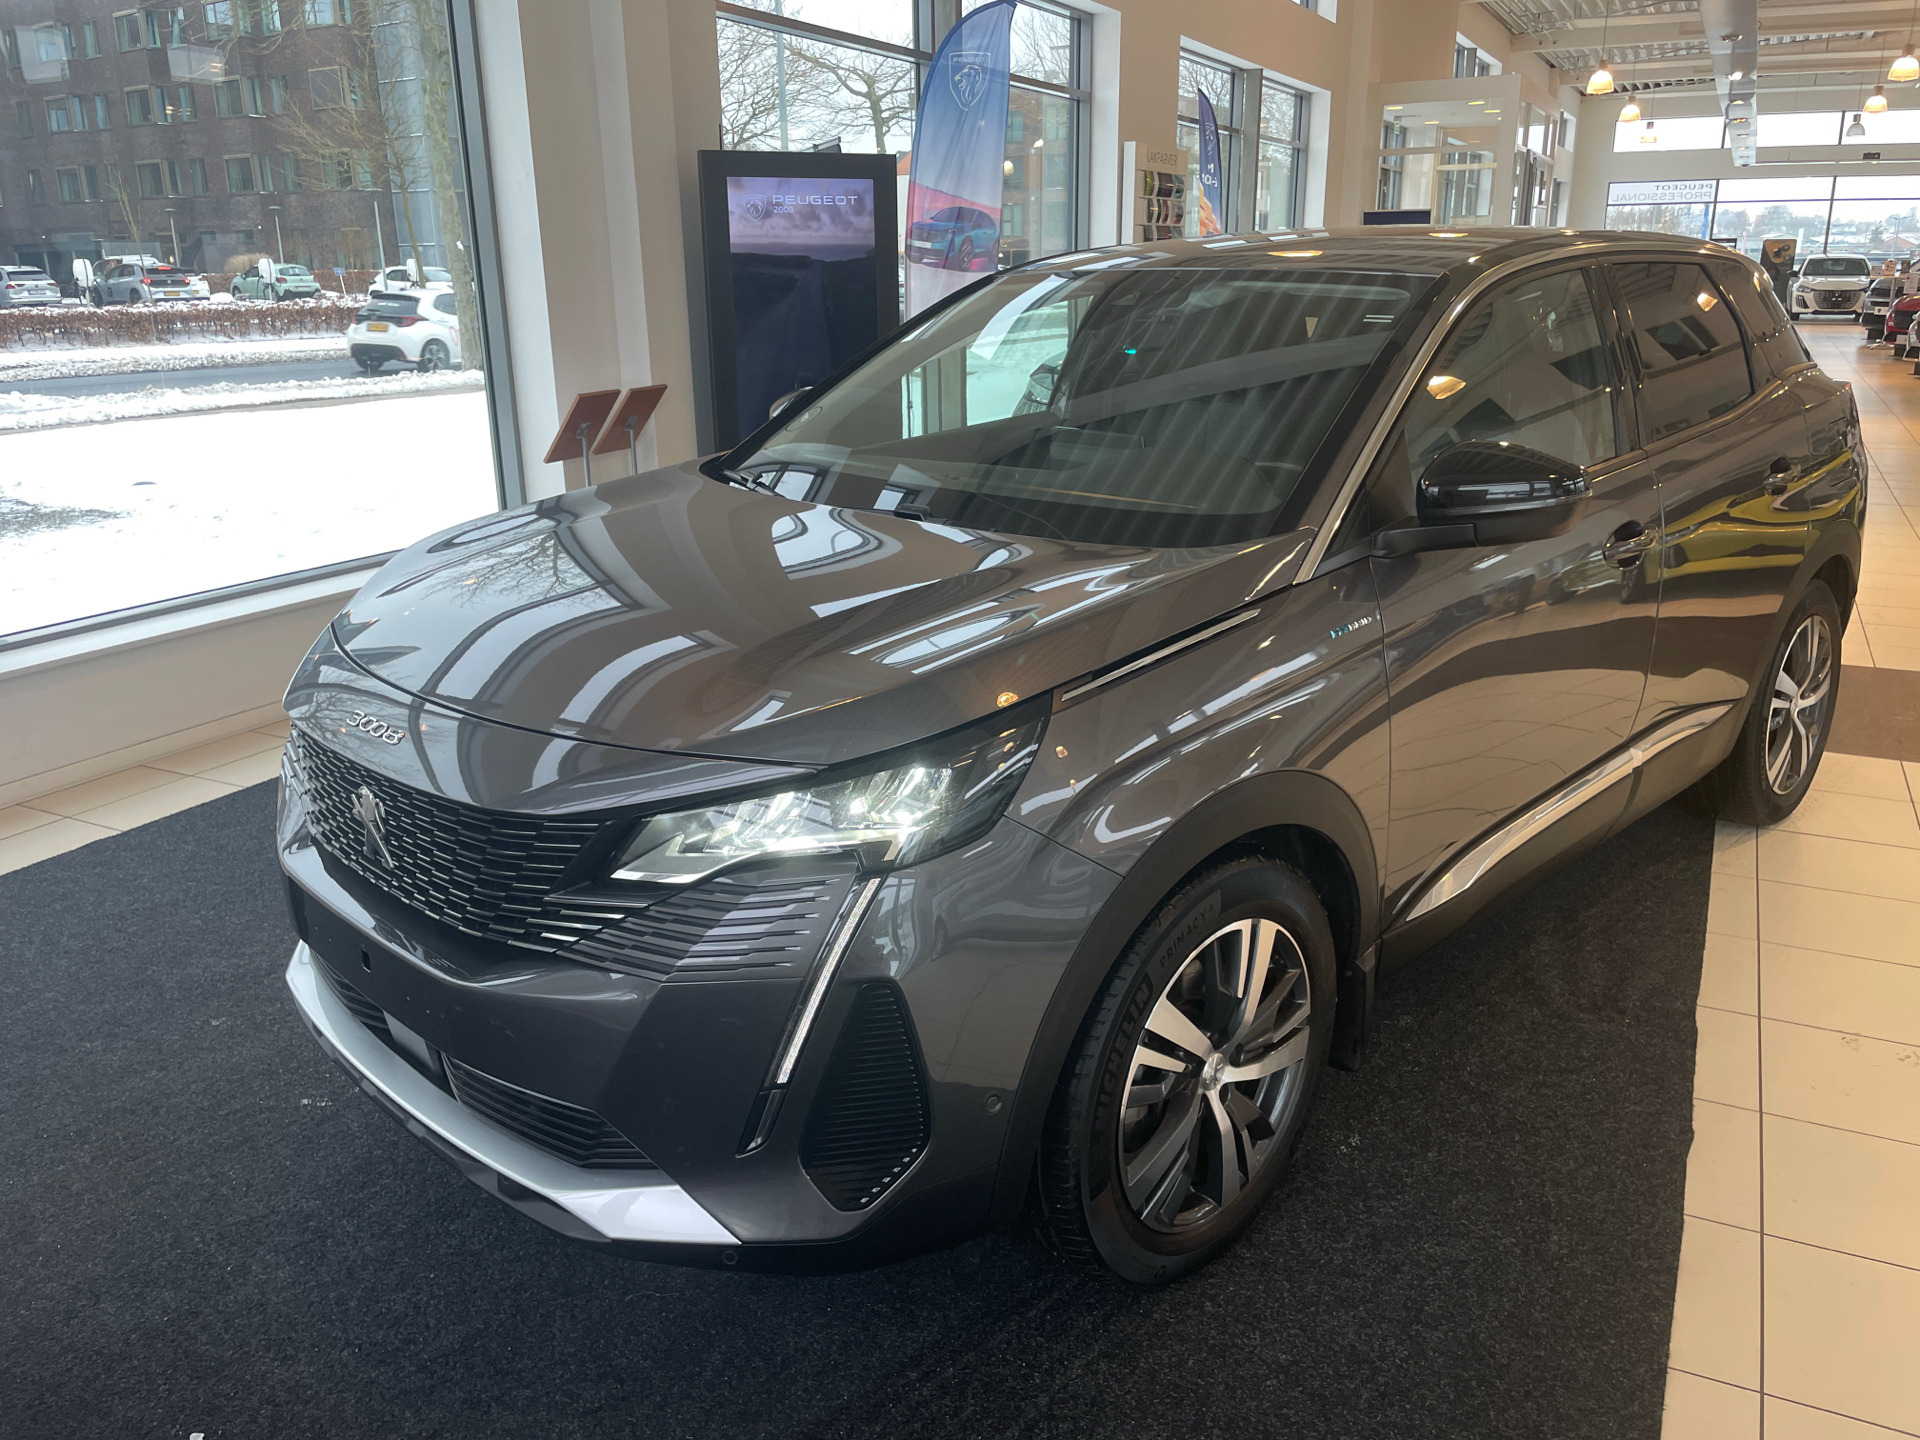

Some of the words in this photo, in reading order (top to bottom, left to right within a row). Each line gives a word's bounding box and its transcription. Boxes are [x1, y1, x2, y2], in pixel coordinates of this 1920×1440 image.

[1147, 150, 1178, 167] LAKFARVER
[772, 194, 858, 205] PEUGEOT
[346, 709, 406, 745] 3008
[1159, 909, 1207, 969] PRIMACY
[1094, 980, 1153, 1134] MICHELIN
